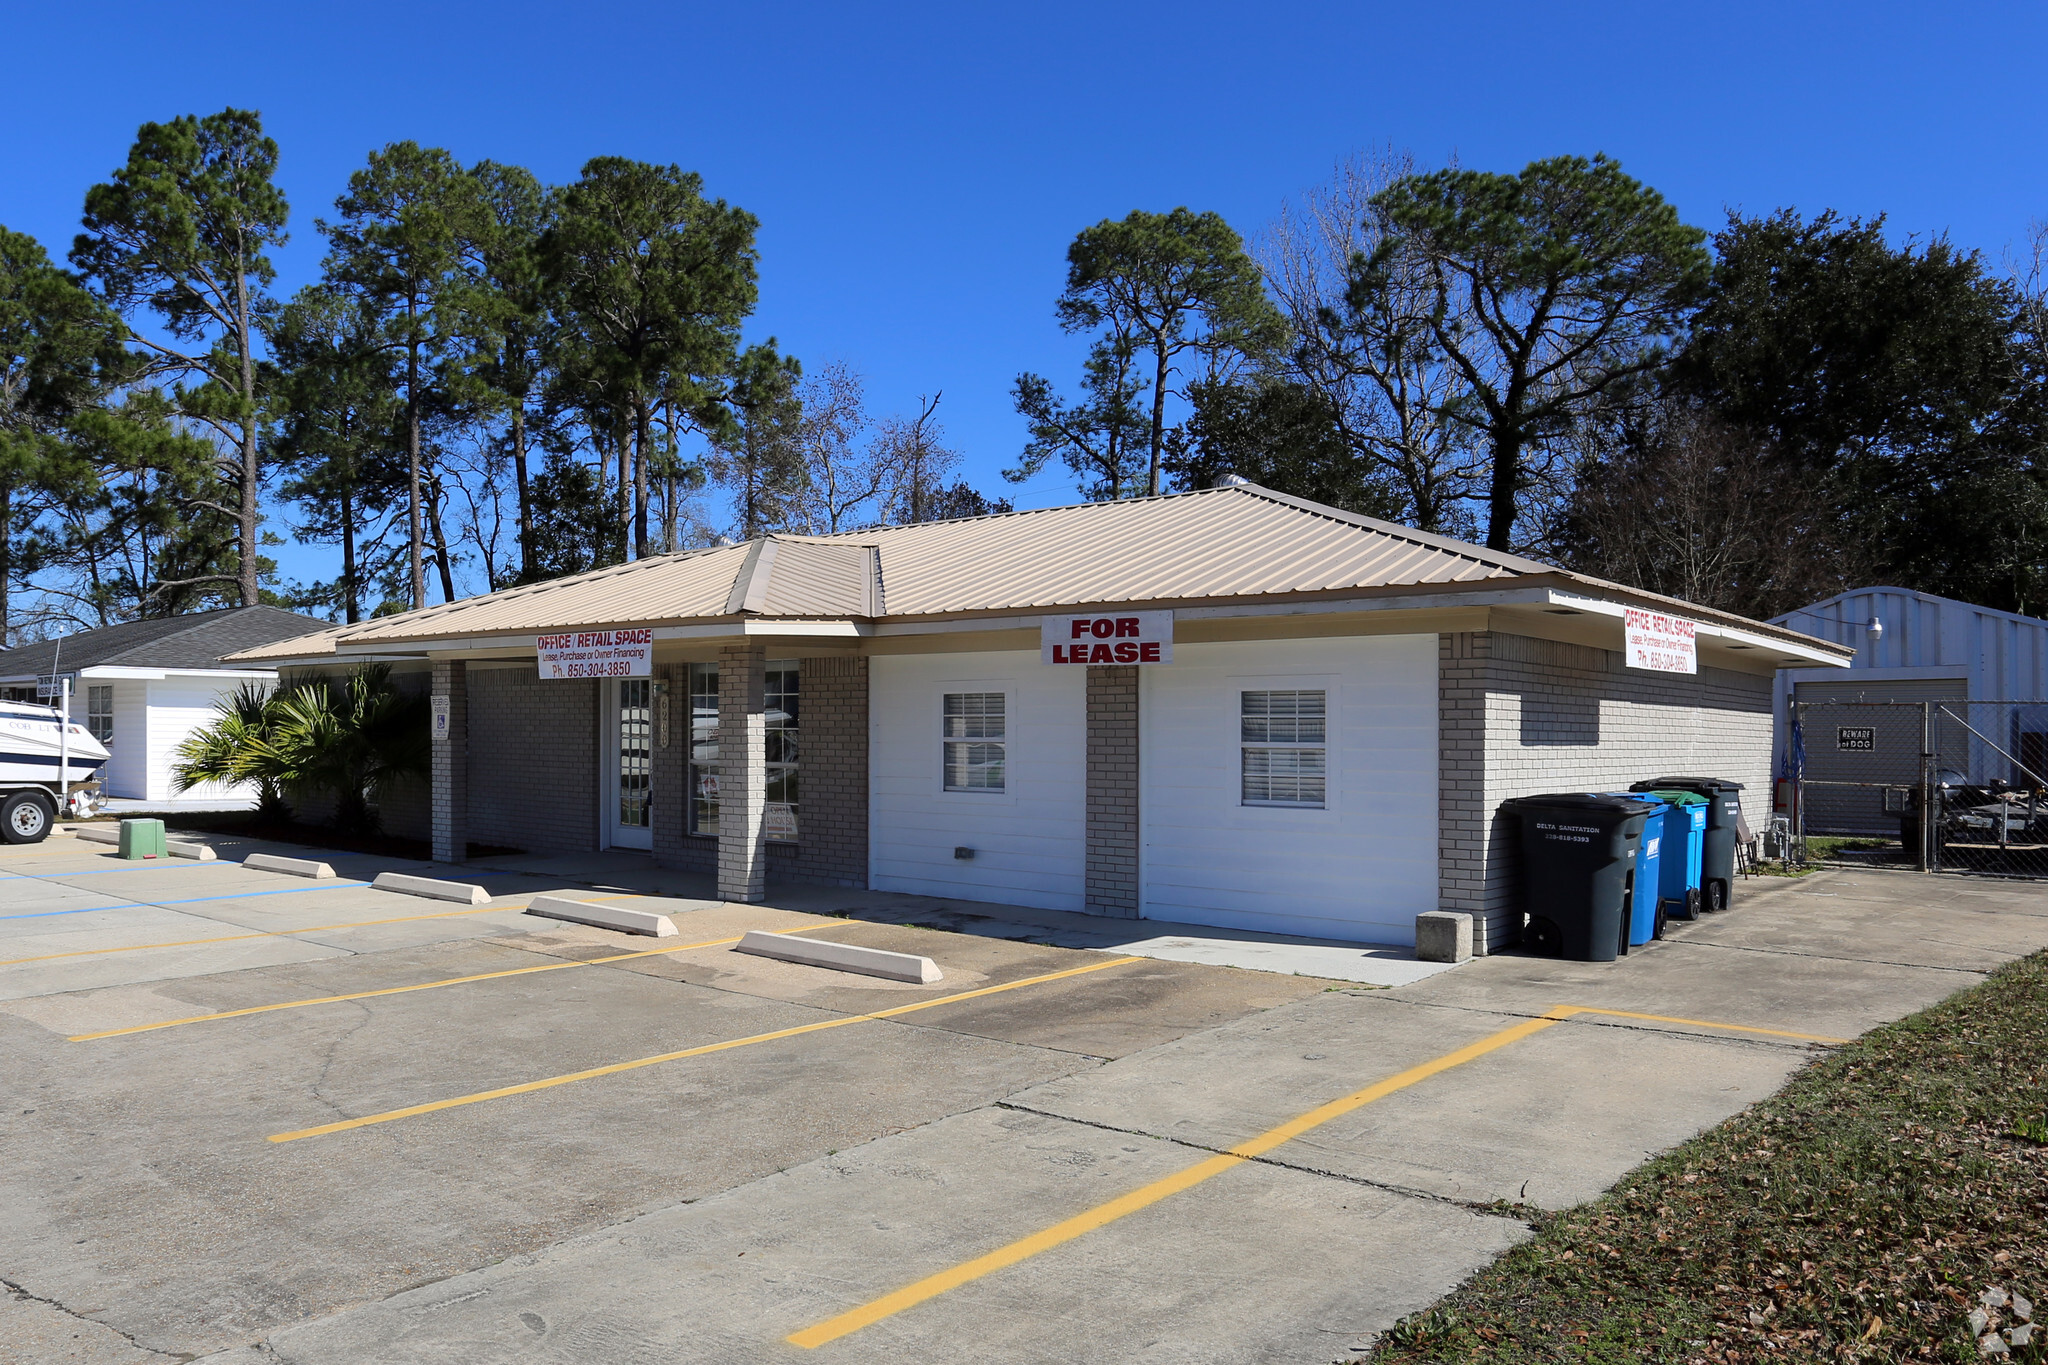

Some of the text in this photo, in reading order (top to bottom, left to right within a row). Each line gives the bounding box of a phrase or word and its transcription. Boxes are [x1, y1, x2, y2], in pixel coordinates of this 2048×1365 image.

[1072, 618, 1140, 639] FOR
[1626, 609, 1650, 630] OFFICE
[1653, 615, 1675, 635] RETAIL
[1675, 620, 1695, 638] SPACE
[537, 634, 571, 650] OFFICE
[577, 632, 613, 648] RETAIL
[615, 629, 652, 645] SPACE
[560, 650, 586, 661] Purchase
[595, 649, 613, 659] Owner
[613, 647, 644, 660] Financing
[1053, 642, 1160, 664] LEASE
[1637, 650, 1648, 667] Ph.
[552, 661, 631, 677] Ph. 850-304-3850
[1842, 730, 1870, 738] BEWARE
[1850, 740, 1870, 748] DOG
[1559, 825, 1600, 833] SANITATION
